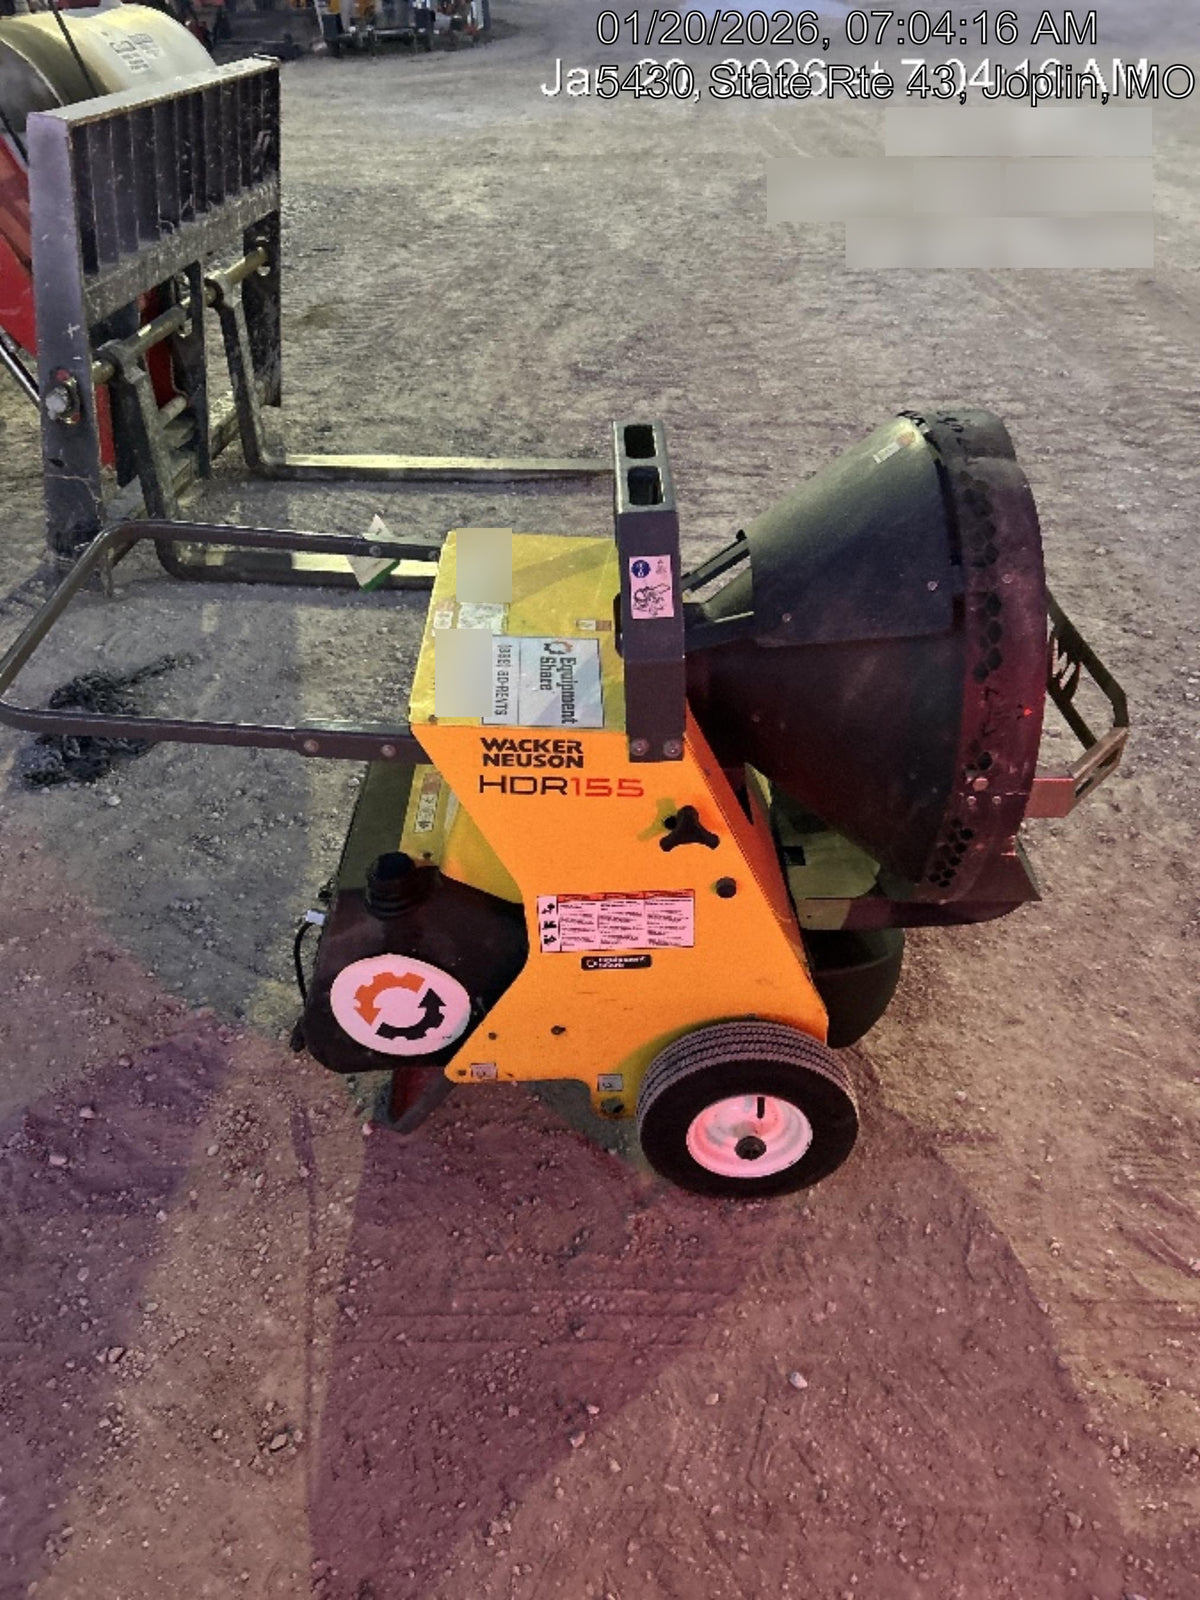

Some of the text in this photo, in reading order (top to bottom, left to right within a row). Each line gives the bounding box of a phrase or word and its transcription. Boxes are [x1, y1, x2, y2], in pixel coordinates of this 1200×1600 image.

[540, 656, 556, 691] Share
[556, 656, 579, 724] Equipment
[480, 738, 583, 755] WACKER
[482, 753, 584, 769] NEUSON
[479, 775, 645, 797] HDR155
